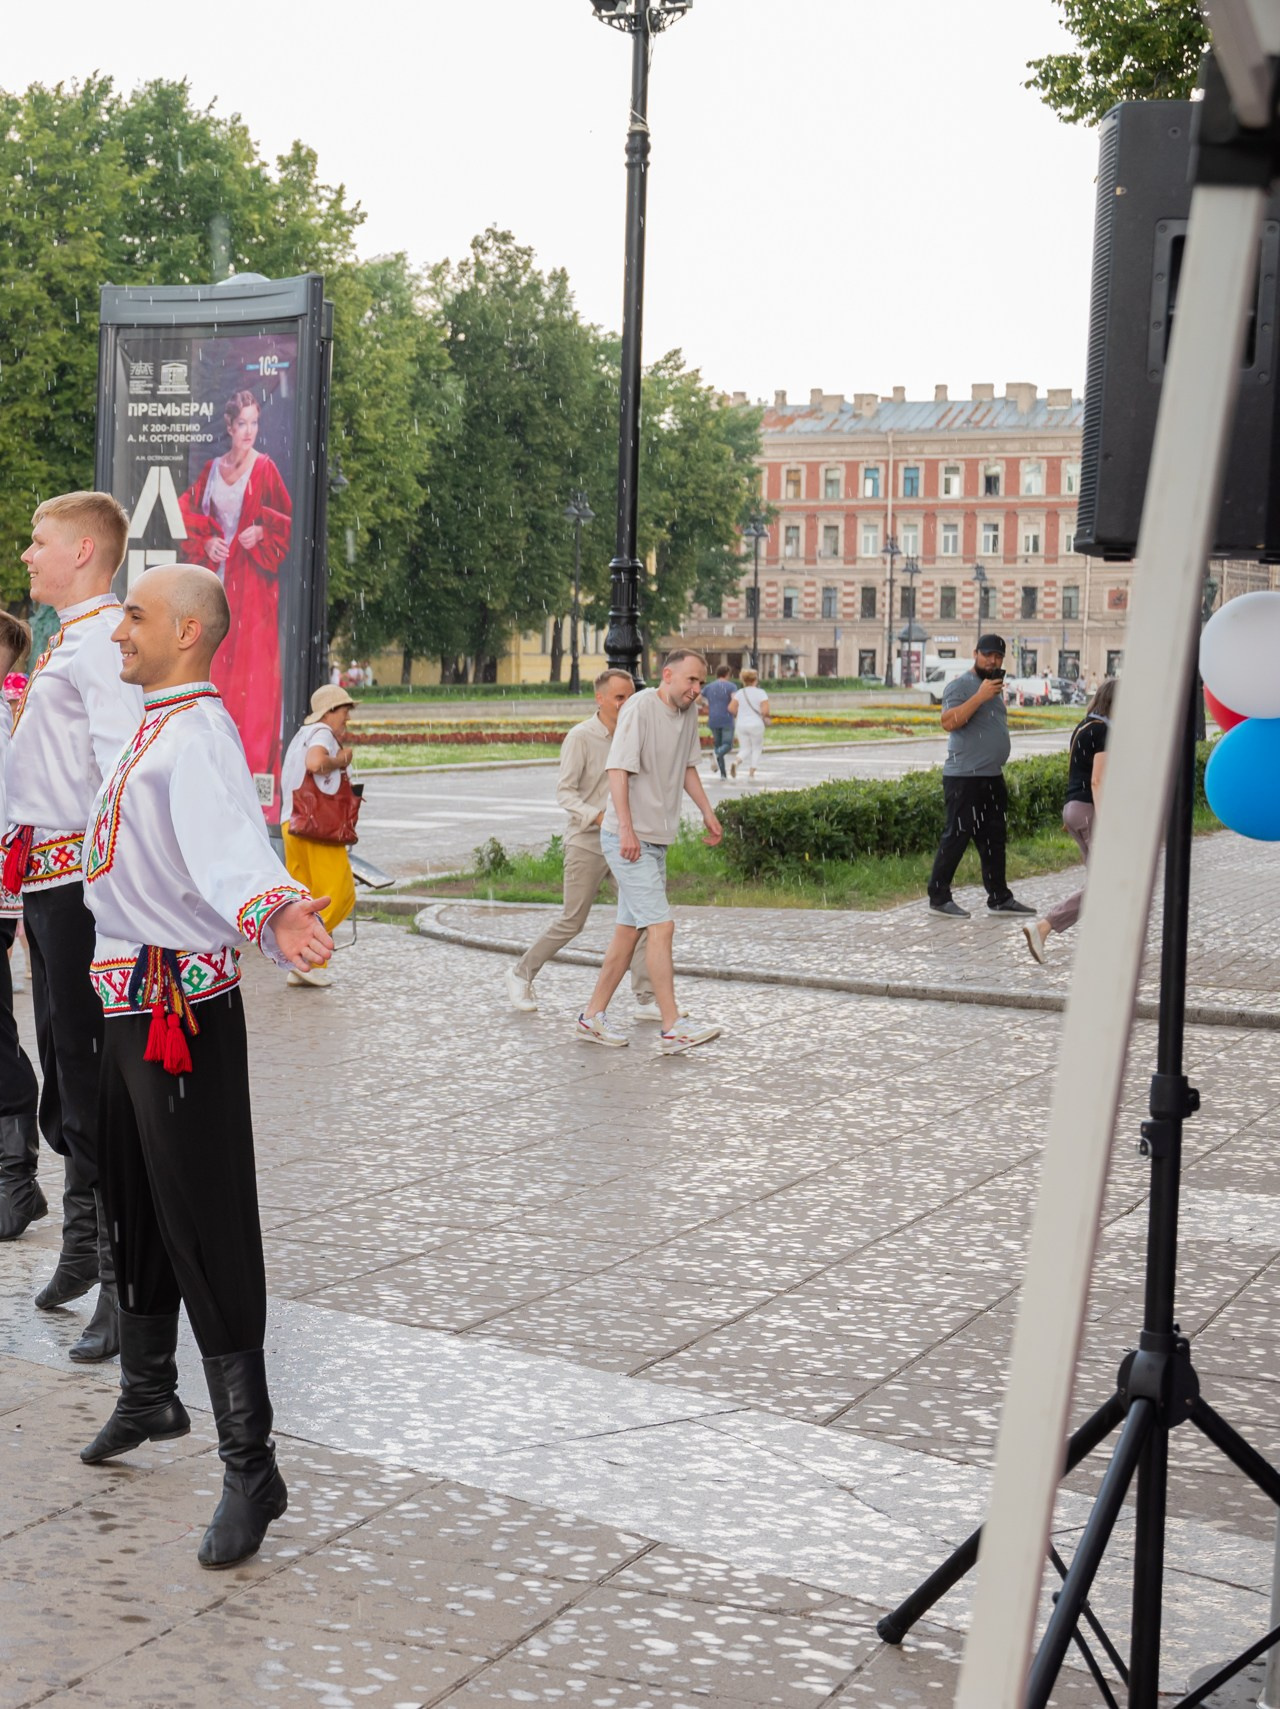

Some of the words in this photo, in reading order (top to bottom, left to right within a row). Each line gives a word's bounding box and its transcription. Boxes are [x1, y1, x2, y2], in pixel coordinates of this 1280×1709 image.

[128, 402, 214, 417] ПРЕМЬЕРА!
[142, 424, 149, 432] К
[150, 423, 201, 432] 200-ЛЕТИЮ
[127, 434, 137, 442] А.
[138, 434, 148, 442] Н.
[149, 433, 214, 442] ОСТРОВСКОГО
